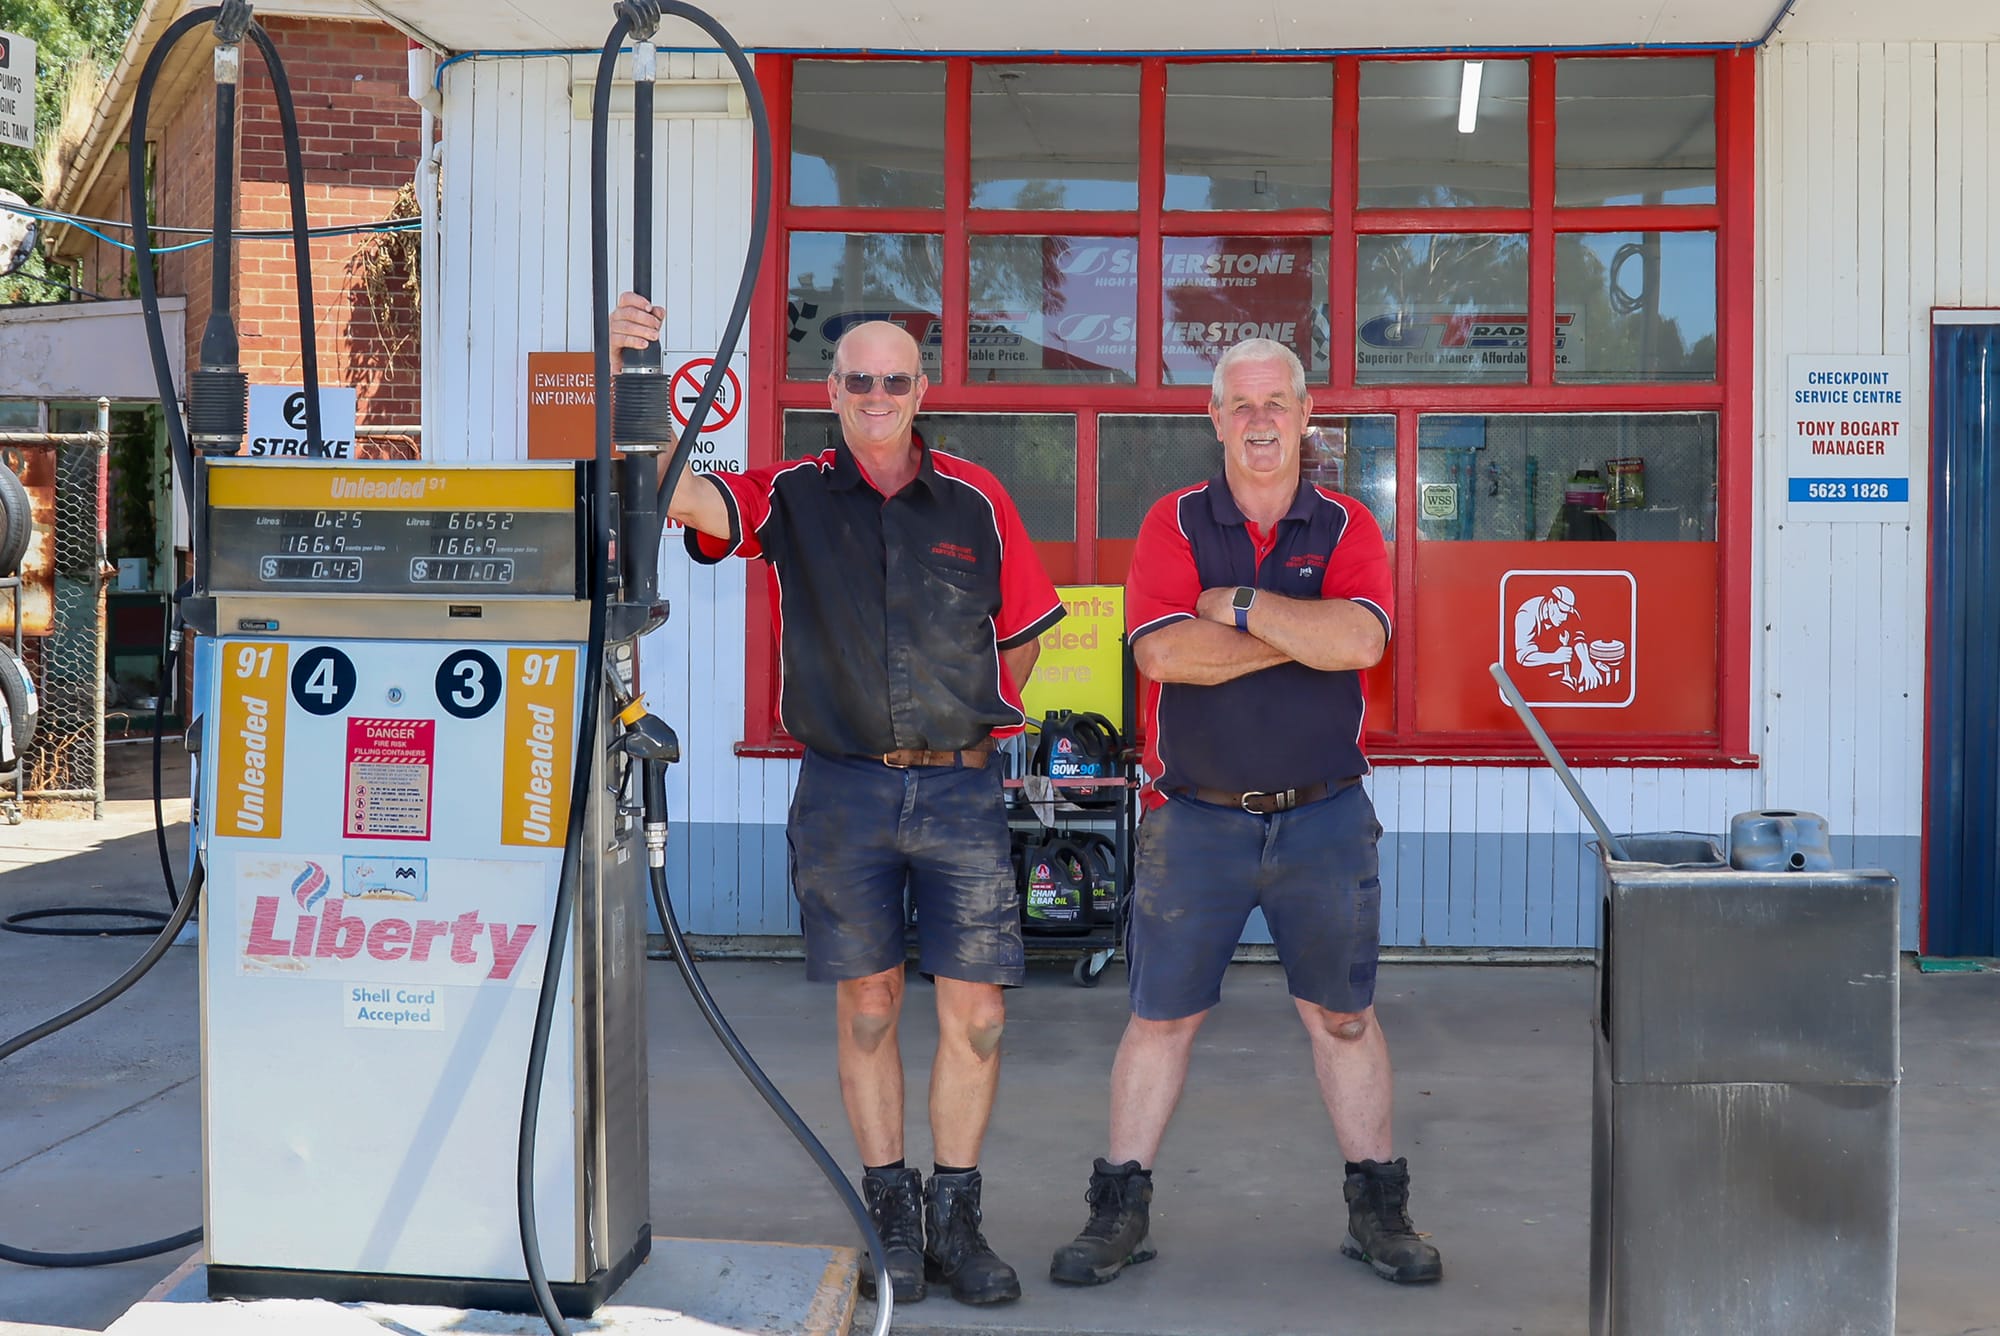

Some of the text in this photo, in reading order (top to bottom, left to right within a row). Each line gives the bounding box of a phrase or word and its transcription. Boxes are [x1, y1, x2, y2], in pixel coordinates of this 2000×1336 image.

[12, 123, 29, 141] TANK
[1096, 277, 1127, 287] HIGH
[1221, 277, 1257, 287] TYRES
[998, 349, 1029, 361] Price.
[1097, 345, 1128, 355] HIGH
[1358, 352, 1404, 366] Superior
[1808, 372, 1889, 385] CHECKPOINT
[1795, 390, 1902, 404] SERVICE CENTRE
[291, 397, 307, 425] 2
[1797, 421, 1900, 436] TONY BOGART
[693, 441, 715, 454] NO
[1812, 440, 1885, 455] MANAGER
[331, 476, 447, 499] Unleaded 91
[1808, 483, 1889, 498] 5623 1826
[1427, 495, 1452, 506] WSS
[256, 511, 363, 529] Litres 0.25
[406, 512, 514, 531] Litres 66.52
[287, 535, 347, 554] 166.9
[437, 537, 497, 555] 166.9
[263, 558, 278, 578] $
[412, 559, 513, 581] $ 111.02
[235, 646, 273, 679] 91
[521, 653, 560, 686] 91
[304, 658, 338, 705] 4
[451, 659, 485, 708] 3
[366, 727, 415, 739] DANGER
[353, 747, 426, 757] FILLING CONTAINERS
[373, 740, 408, 748] FIRE RISK
[236, 695, 269, 833] Unleaded
[522, 703, 555, 843] Unleaded
[1051, 763, 1095, 776] 80W-90
[1031, 889, 1057, 898] CHAIN
[1037, 897, 1054, 905] BAR
[1054, 897, 1068, 905] OIL
[246, 895, 538, 981] Liberty
[351, 987, 436, 1005] Shell Card
[356, 1006, 431, 1025] Accepted
